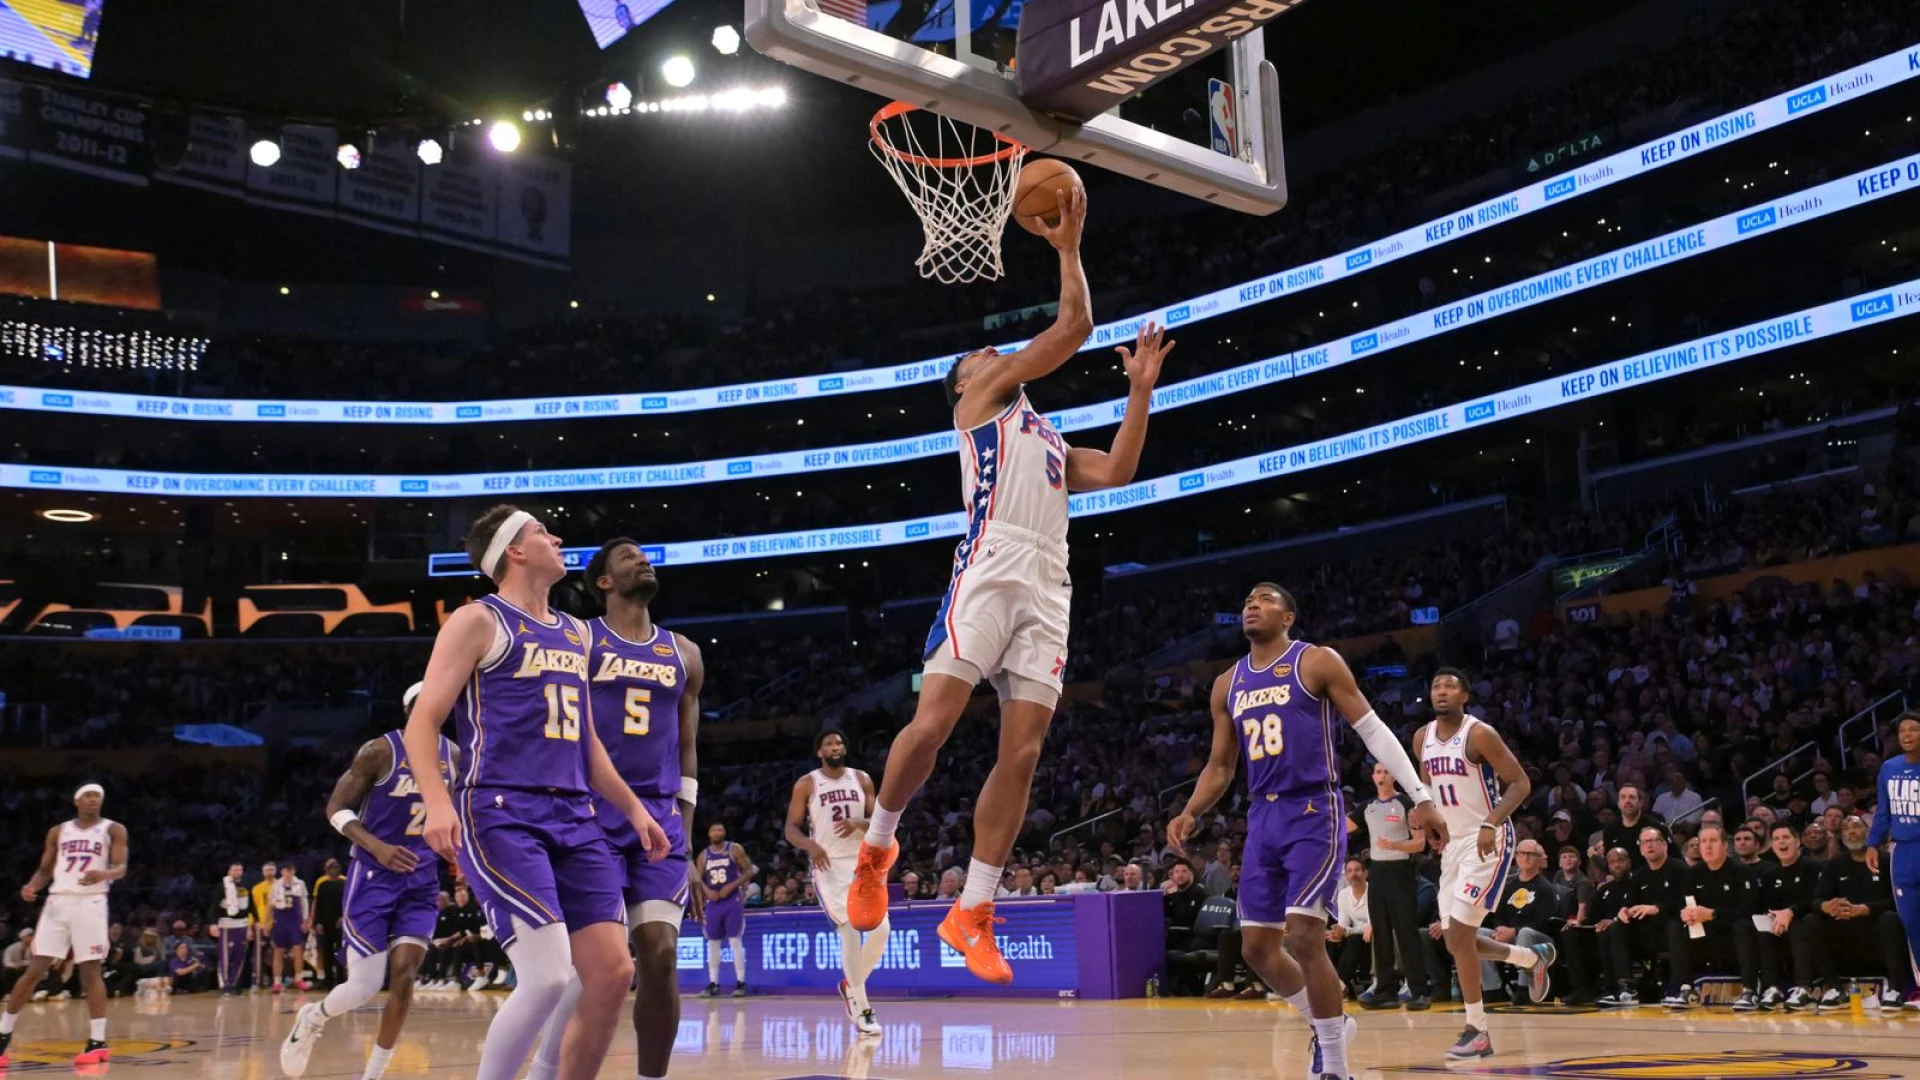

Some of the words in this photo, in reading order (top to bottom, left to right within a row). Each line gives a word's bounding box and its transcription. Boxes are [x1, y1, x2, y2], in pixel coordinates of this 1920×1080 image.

[1070, 0, 1195, 68] LAKE
[1087, 0, 1303, 95] RS.COM
[1792, 90, 1822, 110] UCLA
[1829, 72, 1874, 97] Health
[40, 105, 145, 144] CHAMPIONS
[115, 107, 145, 125] CUP
[56, 131, 128, 164] 2011-12
[1641, 139, 1676, 167] KEEP
[1681, 131, 1701, 153] ON
[1705, 111, 1756, 144] RISING
[1857, 168, 1900, 197] KEEP
[1907, 161, 1920, 182] O
[1426, 220, 1455, 243] KEEP
[1458, 214, 1474, 231] ON
[1478, 196, 1519, 224] RISING
[1741, 212, 1772, 230] UCLA
[1779, 196, 1823, 219] Health
[1239, 284, 1266, 302] KEEP
[1269, 278, 1284, 295] ON
[1287, 265, 1325, 290] RISING
[1433, 306, 1464, 329] KEEP
[1467, 301, 1485, 319] ON
[1488, 269, 1572, 312] OVERCOMING
[1576, 255, 1619, 286] EVERY
[1623, 229, 1706, 270] CHALLENGE
[1856, 299, 1889, 316] UCLA
[1097, 328, 1111, 344] ON
[1561, 373, 1595, 399] KEEP
[1599, 366, 1620, 387] ON
[1623, 347, 1699, 383] BELIEVING
[1702, 338, 1731, 362] IT'S
[1735, 315, 1813, 354] POSSIBLE
[894, 367, 920, 382] KEEP
[922, 364, 937, 377] ON
[1157, 372, 1225, 406] OVERCOMING
[1228, 363, 1261, 389] EVERY
[1264, 348, 1329, 379] CHALLENGE
[534, 402, 561, 414] KEEP
[565, 401, 580, 413] ON
[583, 399, 619, 412] RISING
[717, 389, 744, 403] KEEP
[746, 387, 760, 400] ON
[763, 383, 797, 398] RISING
[1467, 404, 1492, 419] UCLA
[1497, 393, 1532, 413] Health
[136, 400, 167, 414] KEEP
[171, 401, 188, 415] ON
[192, 402, 233, 416] RISING
[343, 406, 372, 418] KEEP
[376, 406, 391, 418] ON
[395, 406, 433, 419] RISING
[1064, 411, 1094, 427] Health
[804, 453, 832, 467] KEEP
[834, 451, 849, 465] ON
[851, 438, 920, 462] OVERCOMING
[923, 434, 954, 452] EVERY
[1259, 455, 1287, 474] KEEP
[1290, 450, 1306, 467] ON
[1308, 433, 1366, 462] BELIEVING
[1369, 431, 1389, 449] IT'S
[1392, 412, 1449, 444] POSSIBLE
[483, 476, 511, 490] KEEP
[514, 475, 530, 489] ON
[533, 472, 605, 487] OVERCOMING
[608, 469, 641, 484] EVERY
[646, 465, 706, 482] CHALLENGE
[1045, 449, 1063, 490] 5
[127, 475, 160, 489] KEEP
[163, 476, 180, 490] ON
[184, 478, 264, 492] OVERCOMING
[268, 479, 304, 492] EVERY
[309, 479, 376, 493] CHALLENGE
[1086, 495, 1106, 511] IT'S
[1109, 484, 1157, 506] POSSIBLE
[702, 542, 728, 558] KEEP
[729, 540, 746, 556] ON
[749, 536, 804, 554] BELIEVING
[806, 533, 826, 549] IT'S
[828, 528, 883, 547] POSSIBLE
[513, 642, 587, 682] LAKERS
[592, 652, 677, 687] LAKERS
[544, 683, 580, 741] 15
[623, 687, 652, 736] 5
[1232, 684, 1291, 720] LAKERS
[1242, 712, 1284, 761] 28
[1424, 755, 1470, 777] PHILA
[819, 788, 860, 807] PHILA
[1438, 783, 1460, 807] 11
[1888, 779, 1920, 801] BLAC
[831, 804, 851, 822] 21
[60, 839, 103, 856] PHILA
[65, 856, 93, 874] 77
[709, 869, 727, 885] 36
[1463, 883, 1481, 899] 76
[1209, 904, 1231, 914] DELTA
[762, 932, 810, 970] KEEP
[815, 931, 842, 970] ON
[994, 934, 1054, 960] Health
